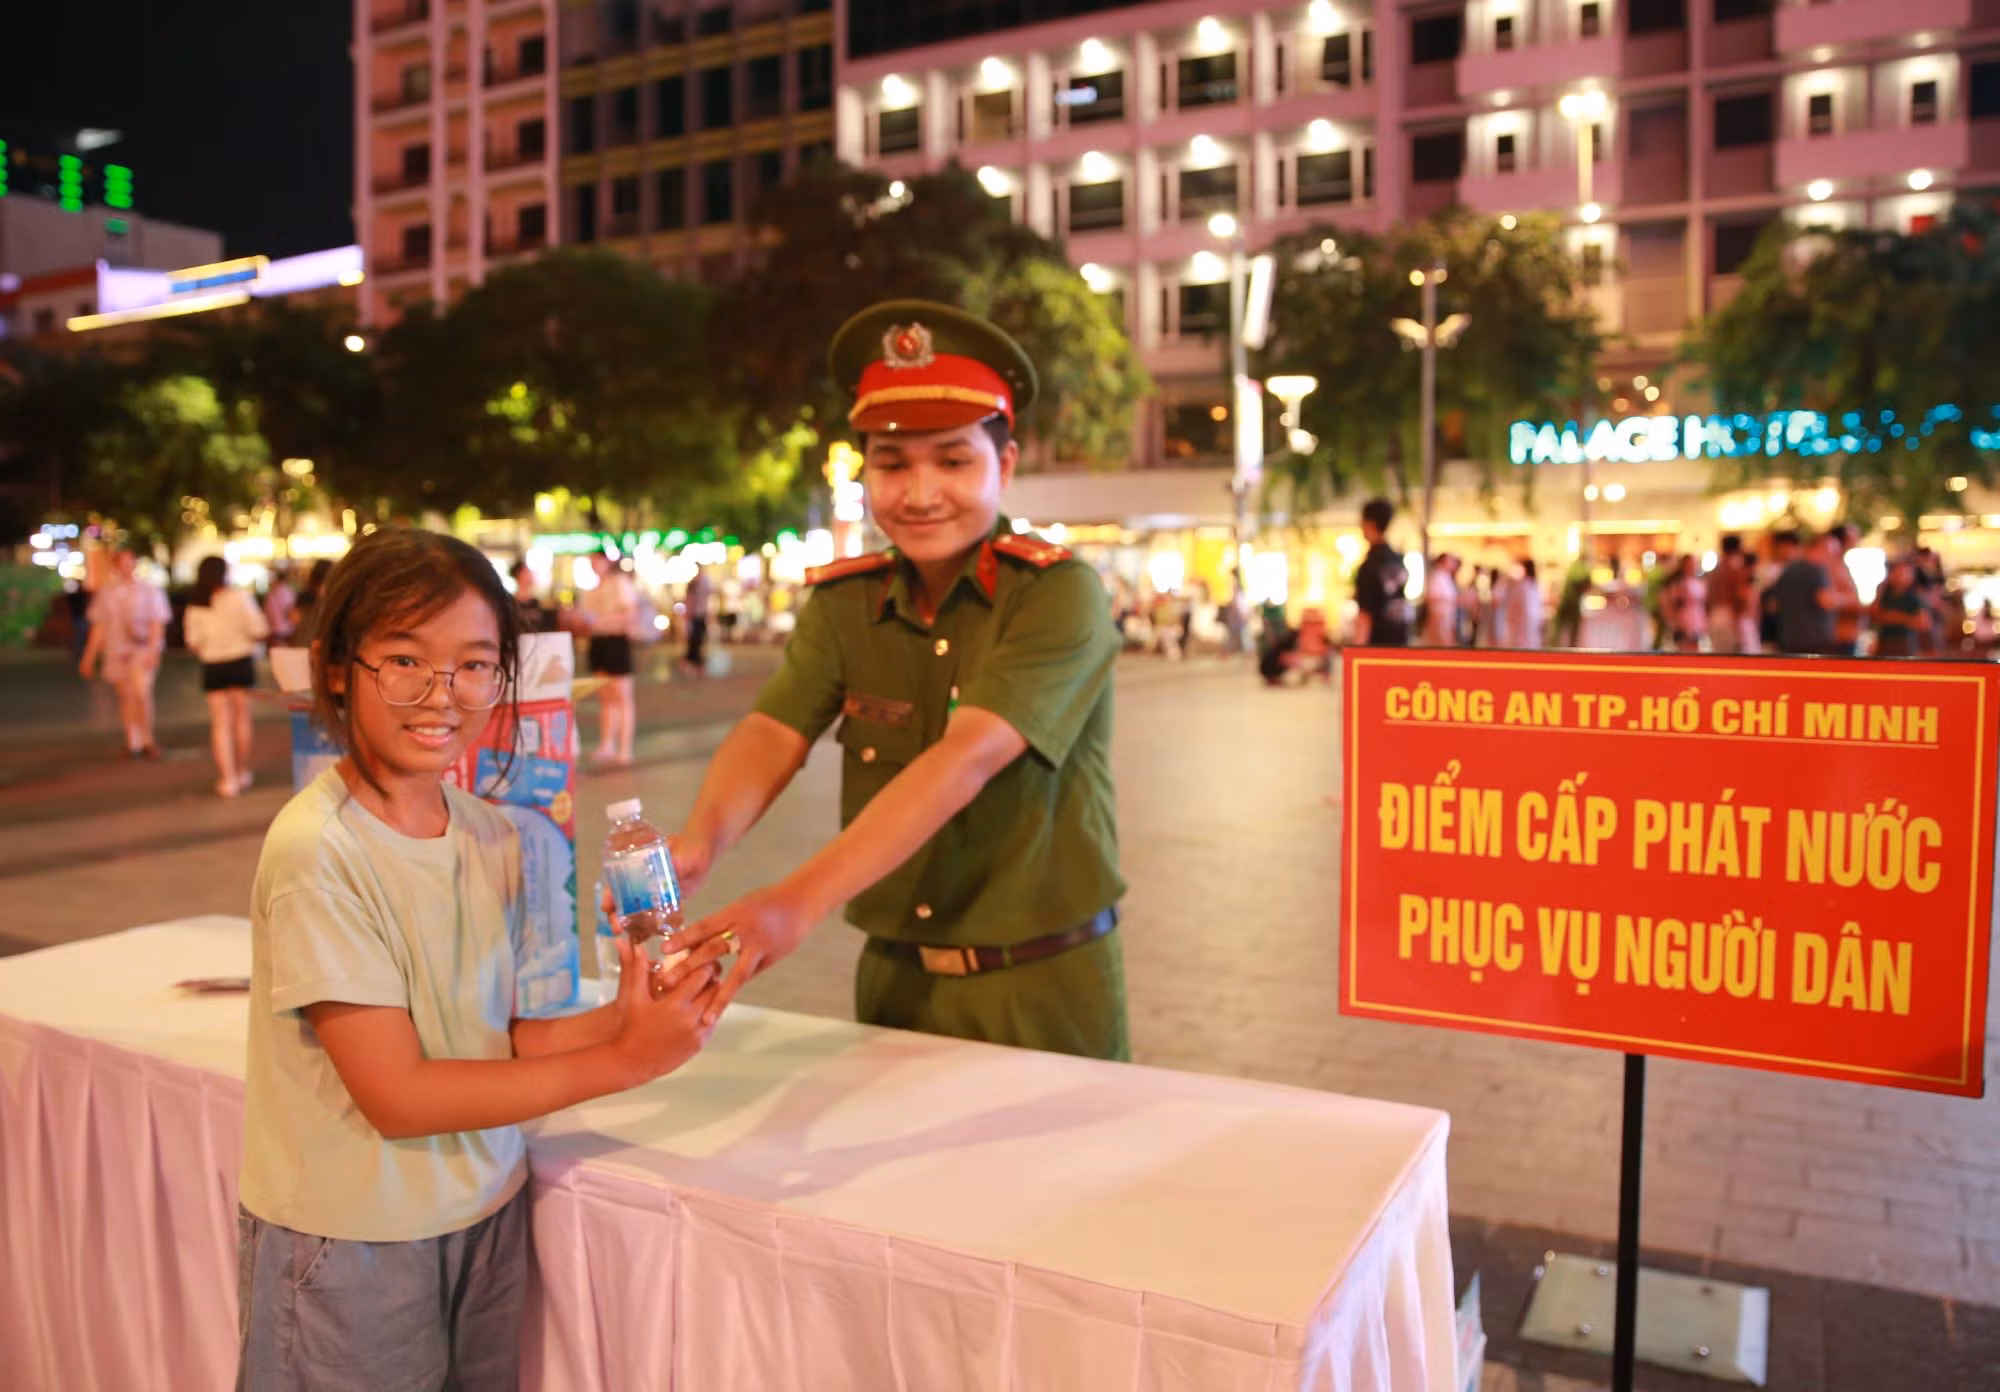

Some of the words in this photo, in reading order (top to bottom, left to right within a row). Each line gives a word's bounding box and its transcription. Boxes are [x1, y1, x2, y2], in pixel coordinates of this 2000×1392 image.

[1509, 414, 1679, 464] PALACE
[1385, 681, 1494, 724] CÔNG
[1503, 691, 1563, 726] AN
[1572, 686, 1700, 731] TP.HỒ
[1711, 694, 1789, 736] CHÍ
[1803, 702, 1938, 742] MINH
[1377, 759, 1503, 858] ĐIỂM
[1516, 771, 1618, 865] CẤP
[1633, 788, 1771, 879] PHÁT
[1786, 798, 1942, 893] NƯỚC
[1398, 893, 1525, 983] PHỤC
[1537, 907, 1601, 995] VỤ
[1614, 909, 1777, 1000] NGƯỜI
[1791, 921, 1912, 1015] DÂN
